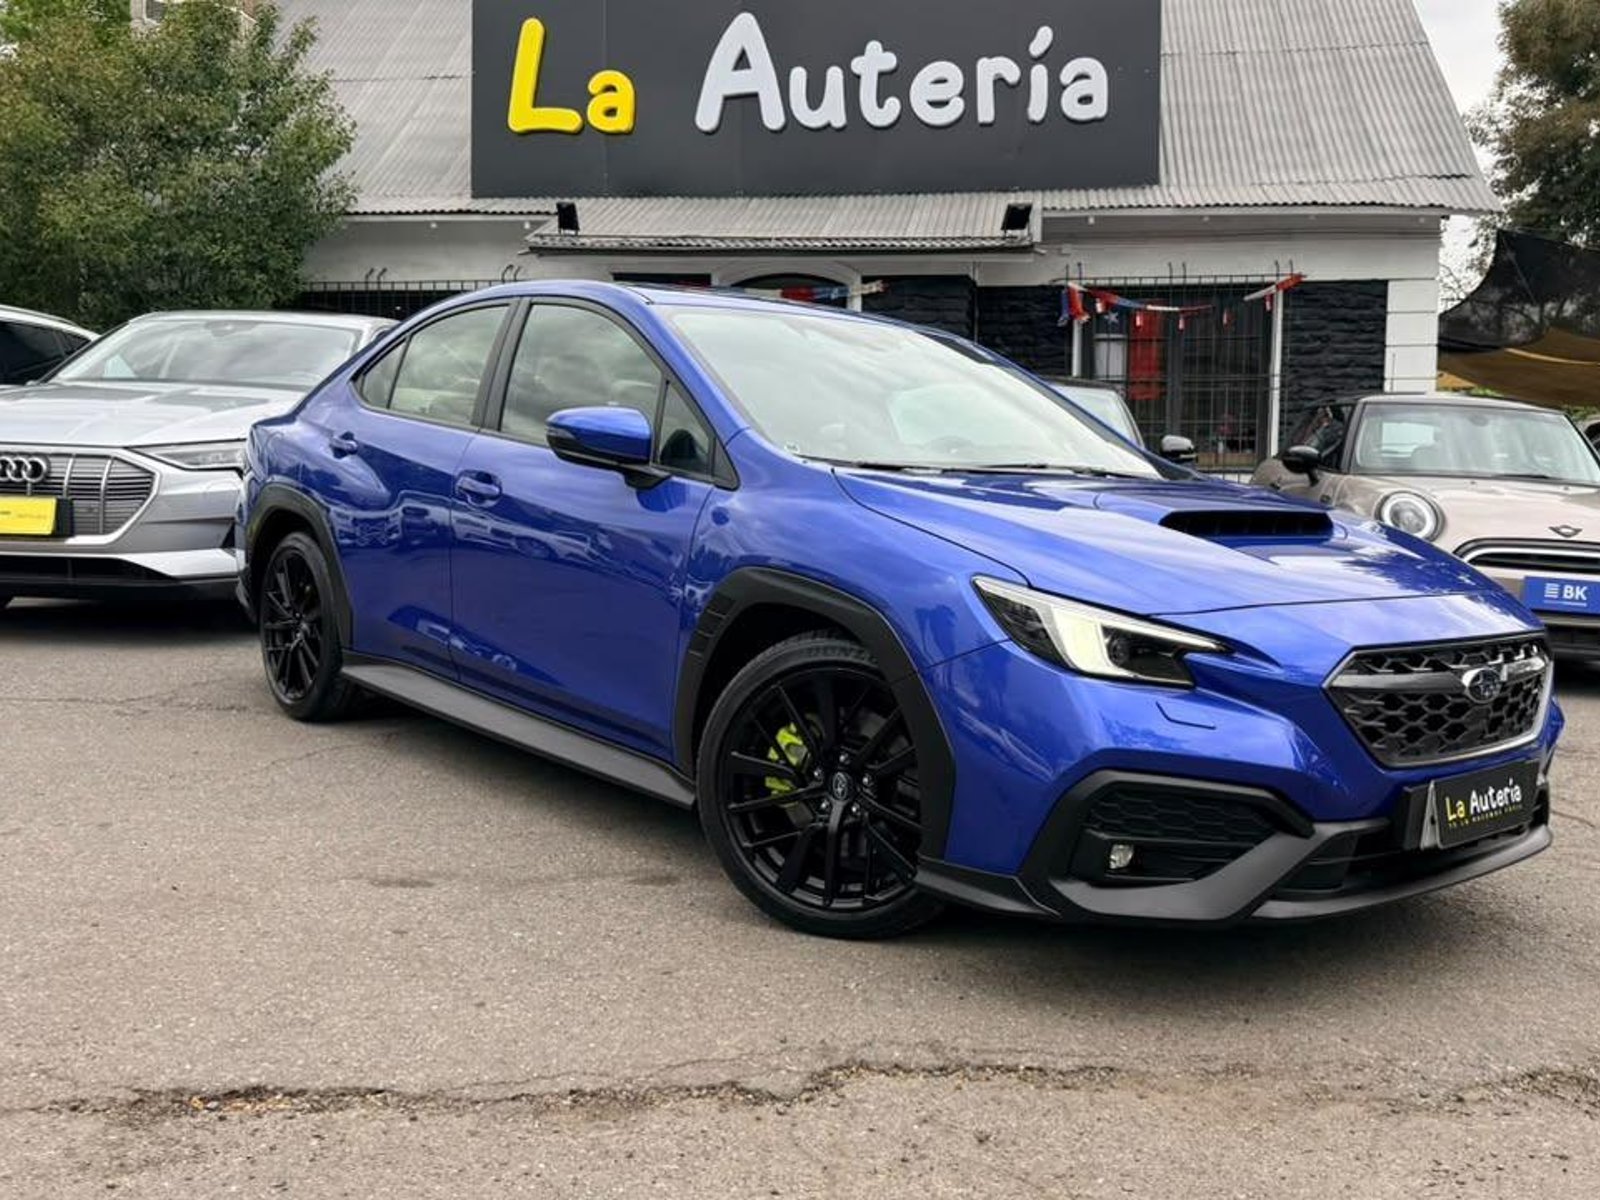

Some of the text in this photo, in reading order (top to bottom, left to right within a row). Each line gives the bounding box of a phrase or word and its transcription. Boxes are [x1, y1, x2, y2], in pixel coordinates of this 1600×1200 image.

[507, 11, 1109, 135] La Autería
[1563, 584, 1587, 600] BK
[1445, 797, 1466, 821] La
[1470, 778, 1522, 815] Autería
